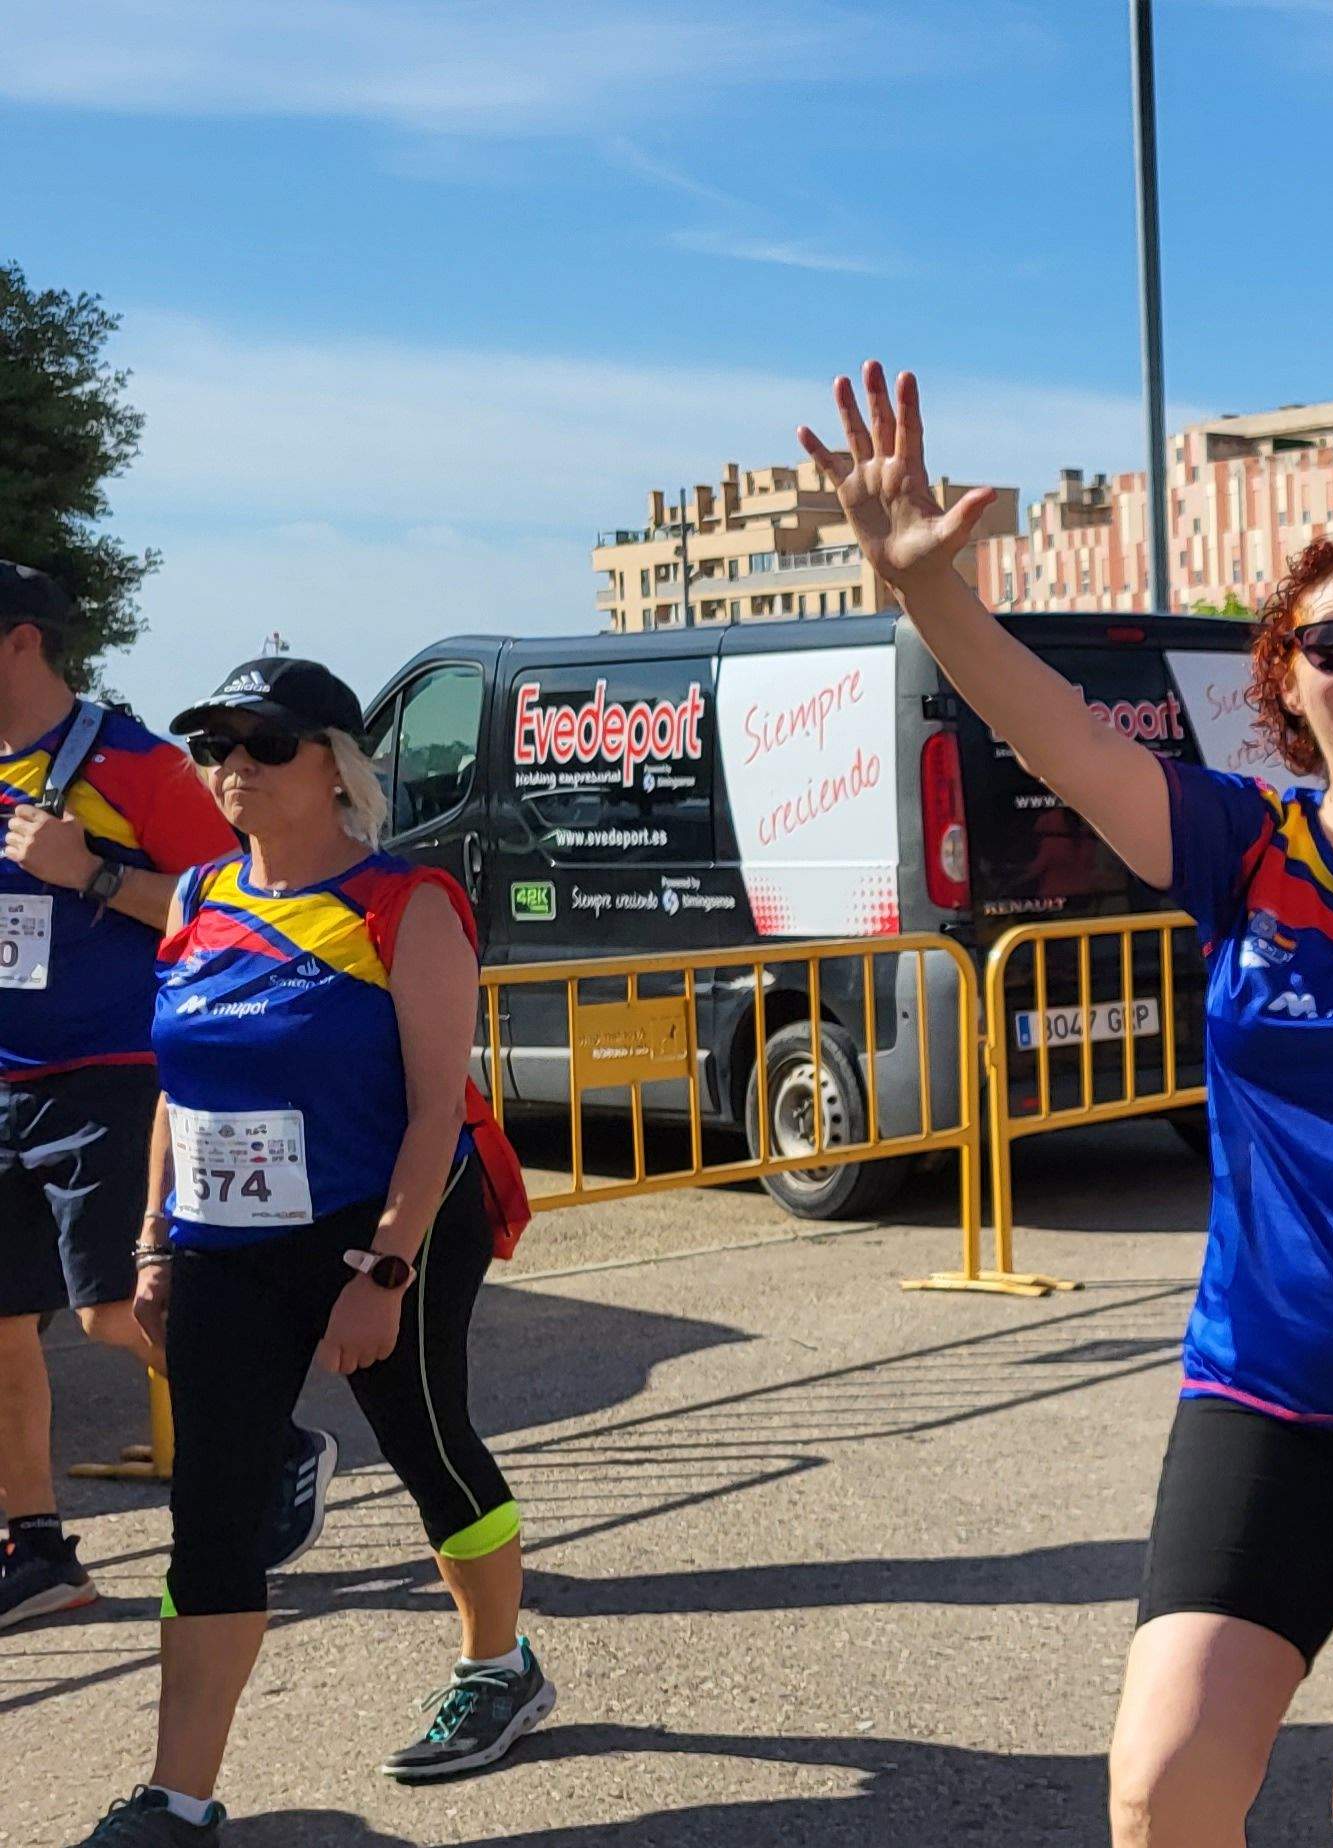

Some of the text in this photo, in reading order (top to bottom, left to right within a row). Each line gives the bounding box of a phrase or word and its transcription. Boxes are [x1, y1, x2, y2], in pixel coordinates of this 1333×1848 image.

[224, 679, 271, 693] adidas
[744, 669, 865, 765] Siempre
[514, 678, 705, 787] Evedeport
[559, 769, 621, 788] empresarial
[757, 746, 881, 846] creciendo
[556, 828, 667, 849] www.evedeport.es
[984, 897, 1067, 916] RENAULT
[192, 1168, 271, 1202] 574
